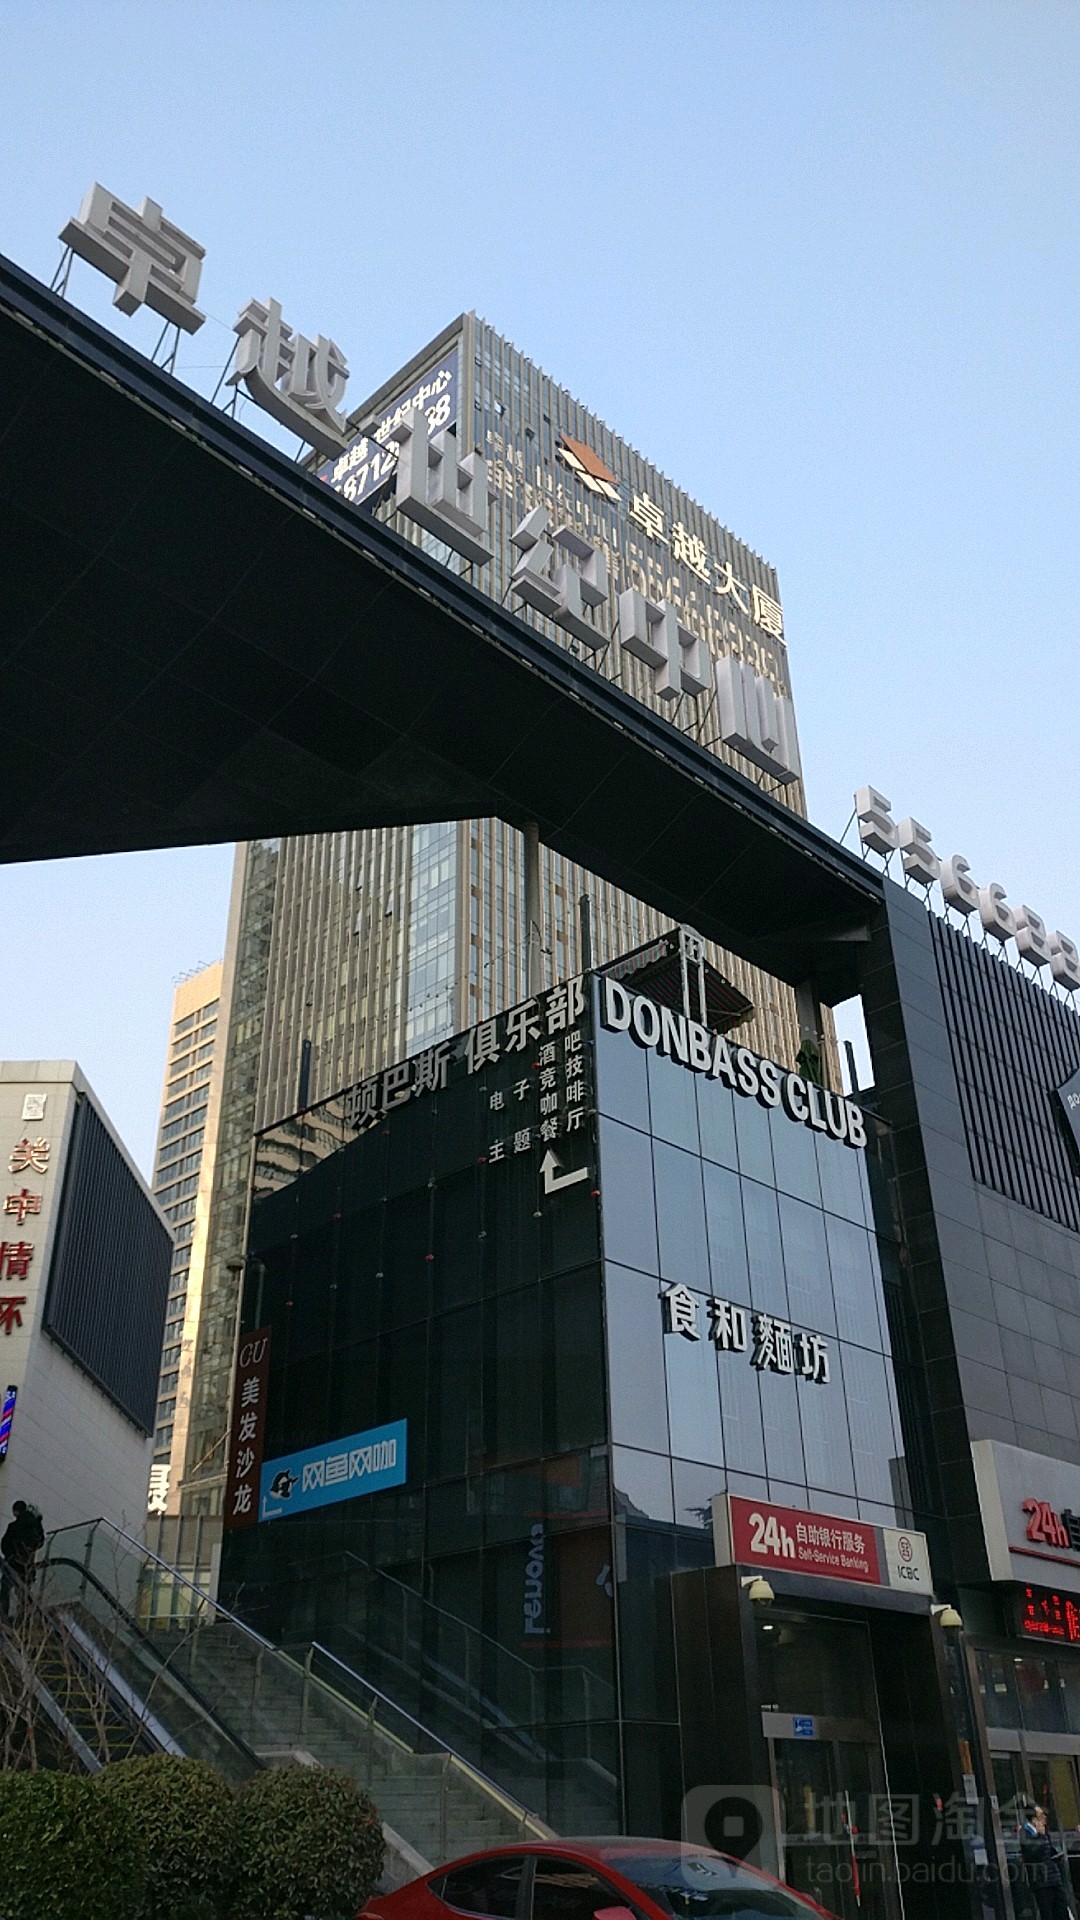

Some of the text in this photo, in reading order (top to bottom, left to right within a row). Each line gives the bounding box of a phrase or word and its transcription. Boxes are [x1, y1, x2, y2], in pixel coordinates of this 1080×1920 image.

[629, 491, 787, 647] 卓越大厦
[344, 975, 585, 1128] 顿巴斯俱乐部
[538, 1029, 583, 1067] 酒吧
[604, 977, 868, 1149] DONBASS CLUB
[489, 1054, 585, 1112] 电子竞技
[539, 1079, 585, 1117] 咖啡
[488, 1107, 585, 1164] 主题餐厅
[239, 1337, 269, 1369] CU
[232, 1375, 261, 1516] 美发沙龙
[302, 1438, 397, 1493] 网鱼网咖
[749, 1512, 796, 1559] 24h
[796, 1522, 866, 1555] 自助银行服务
[1022, 1497, 1070, 1548] 24h
[798, 1547, 870, 1574] Self-Service Banking
[897, 1565, 920, 1581] ICBC
